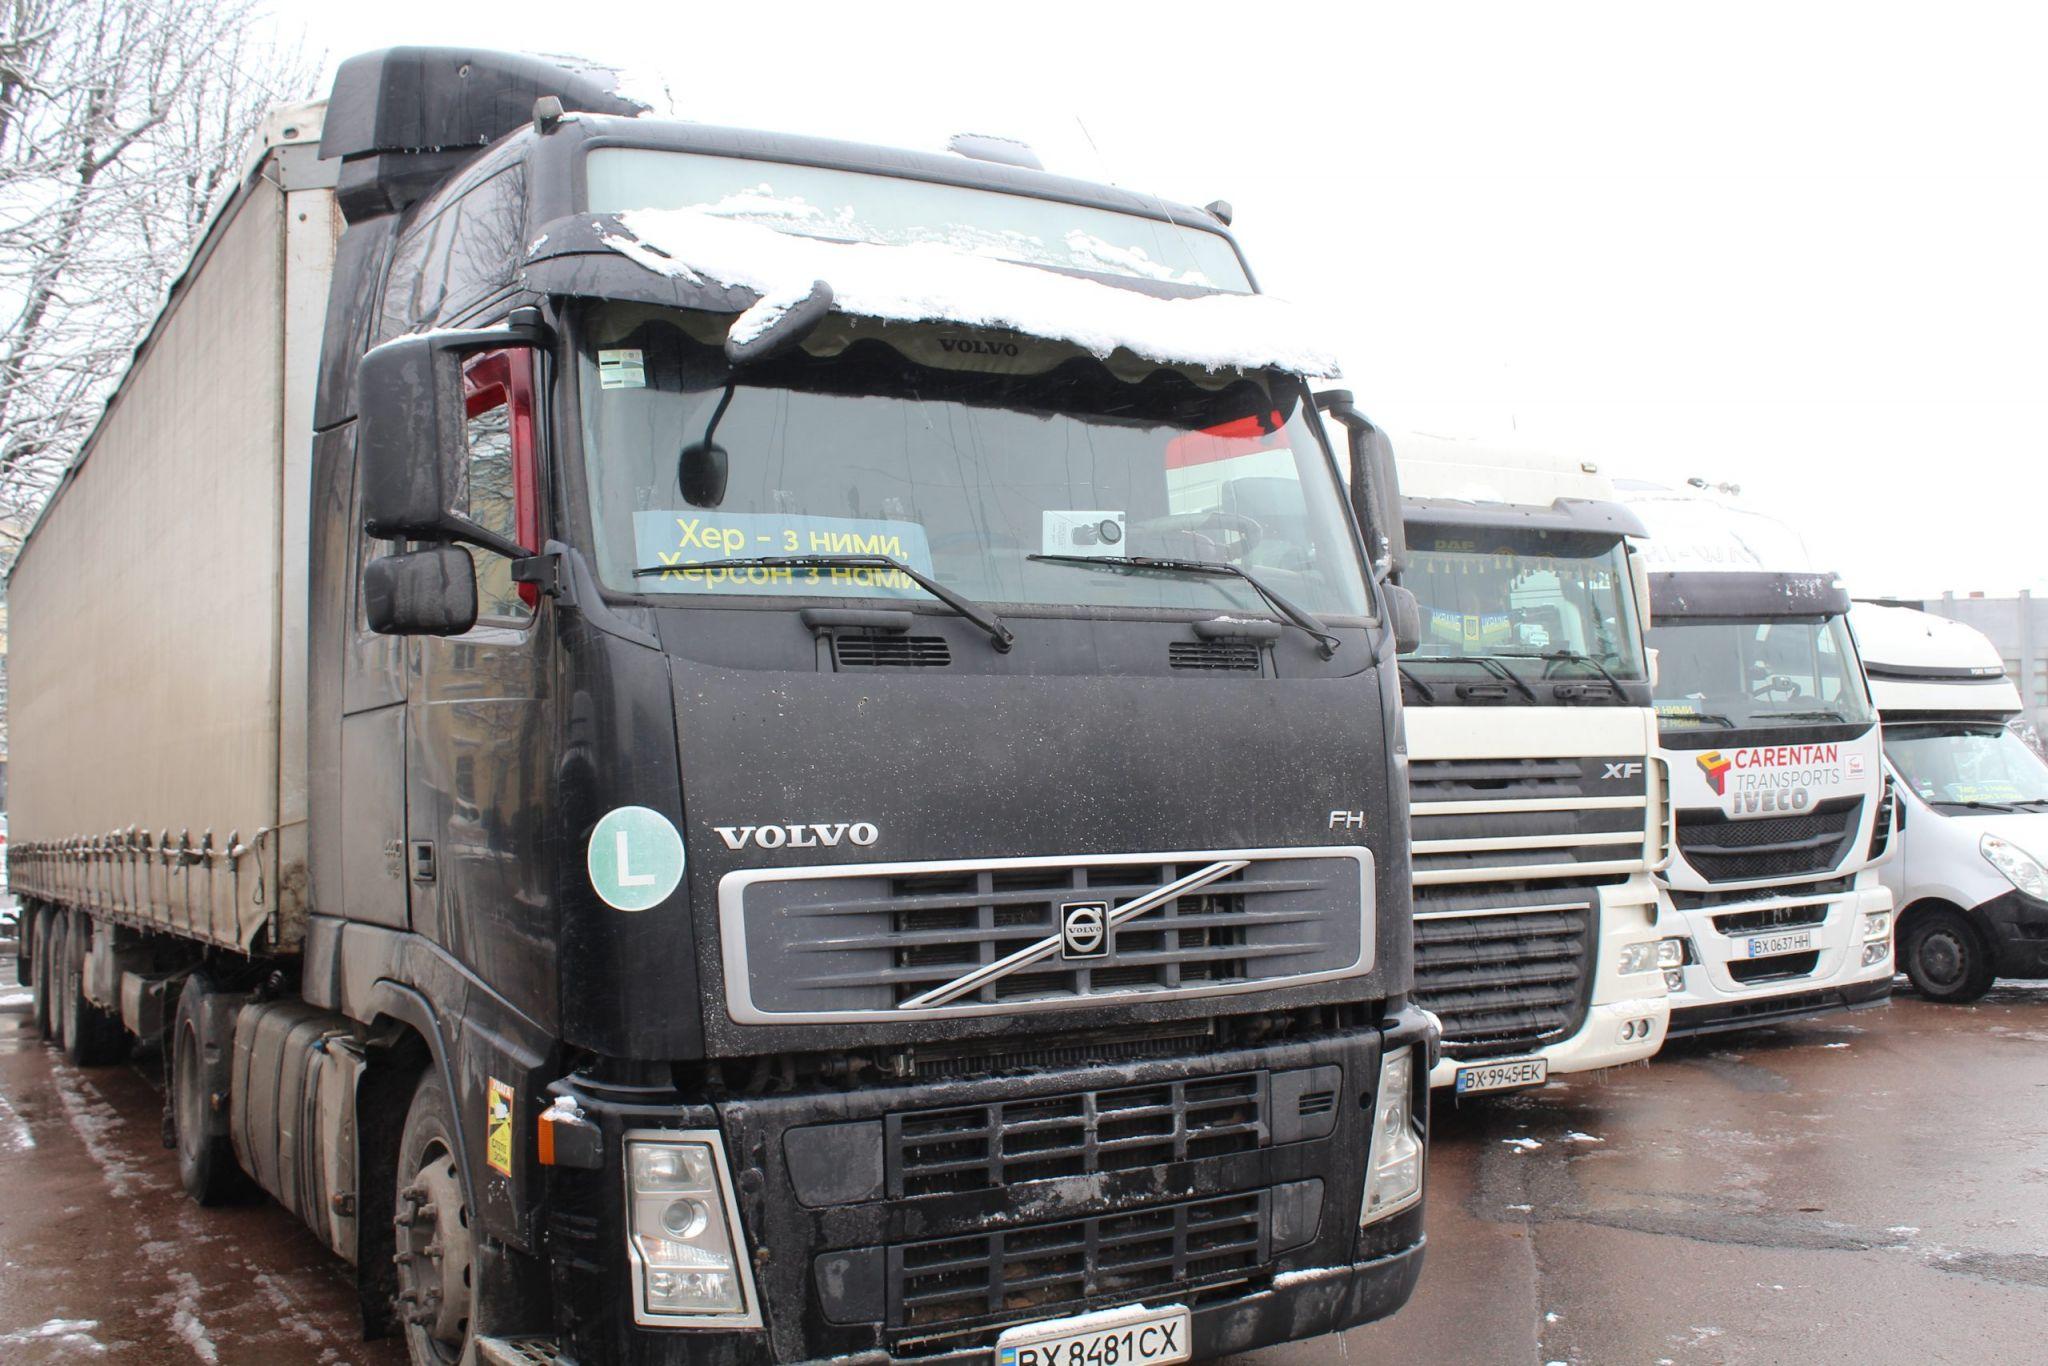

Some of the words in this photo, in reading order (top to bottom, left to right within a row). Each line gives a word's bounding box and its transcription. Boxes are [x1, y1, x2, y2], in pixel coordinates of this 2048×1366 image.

[938, 338, 1019, 357] VOLVO
[676, 518, 746, 557] Хер
[783, 529, 800, 552] з
[809, 531, 909, 561] ними,
[657, 551, 793, 590] Херсон
[1735, 745, 1838, 768] CARENTAN
[1601, 762, 1643, 779] XF
[1736, 768, 1840, 791] TRANSPORTS
[1733, 787, 1809, 814] IVECO
[1329, 810, 1364, 829] FH
[714, 822, 879, 850] VOLVO
[616, 831, 656, 887] L
[1068, 926, 1102, 934] VOLVO
